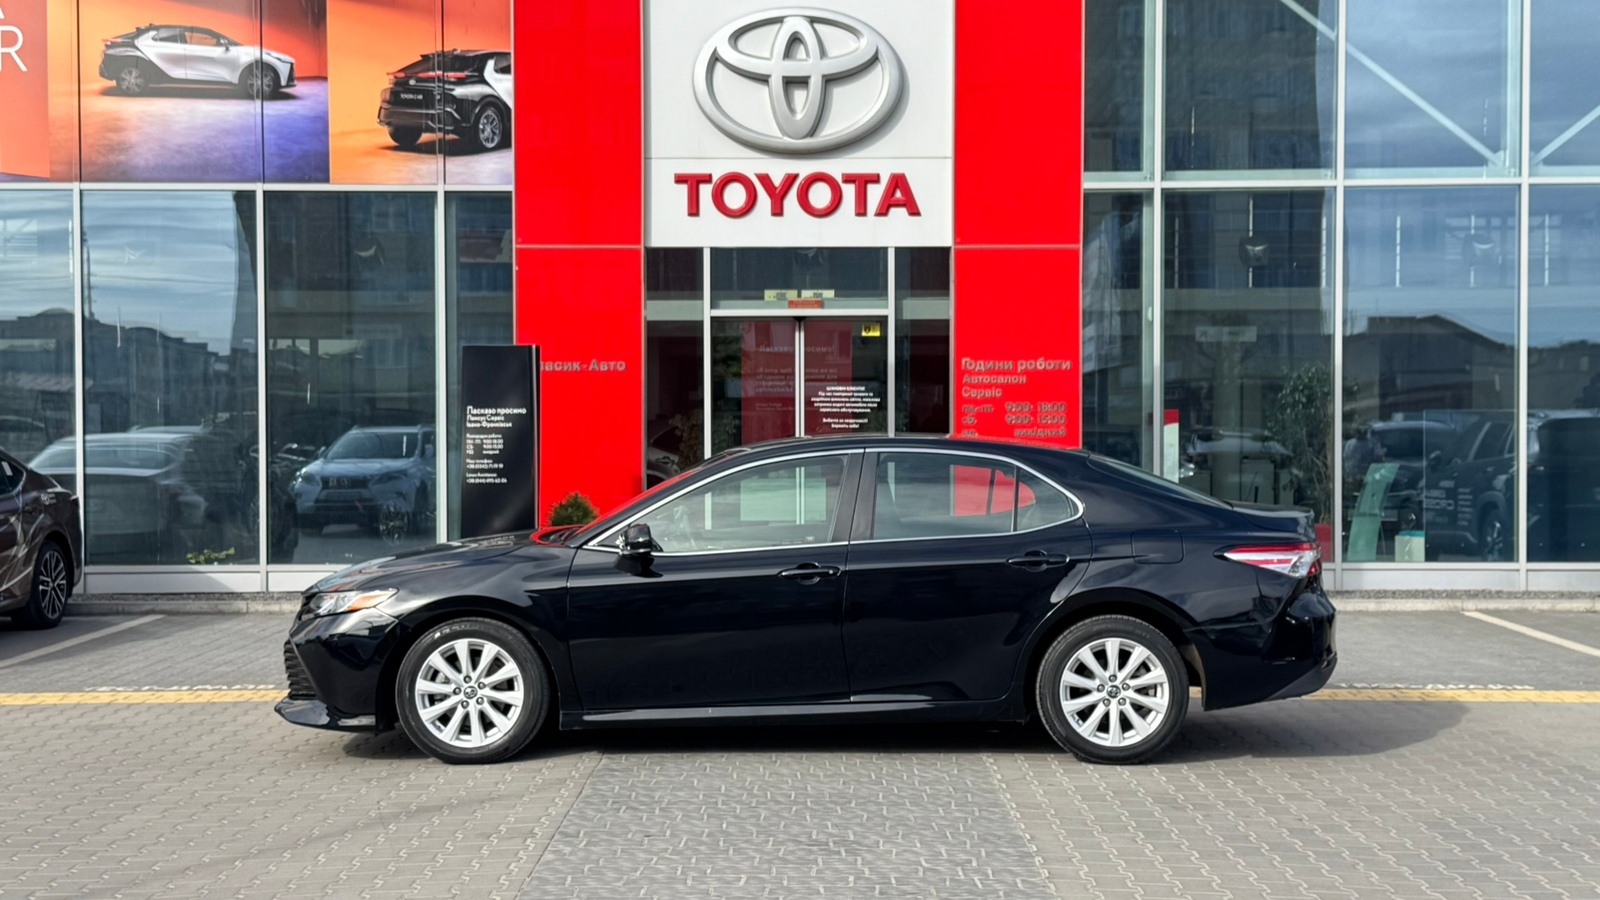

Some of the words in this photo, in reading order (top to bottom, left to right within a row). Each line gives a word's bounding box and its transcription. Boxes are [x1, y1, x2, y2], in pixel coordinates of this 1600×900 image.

[674, 171, 922, 219] TOYOTA
[961, 357, 1013, 372] Години
[1017, 357, 1072, 373] роботи
[962, 374, 1026, 384] Автосалон
[962, 386, 1002, 399] Сервіс
[497, 408, 527, 416] просимо
